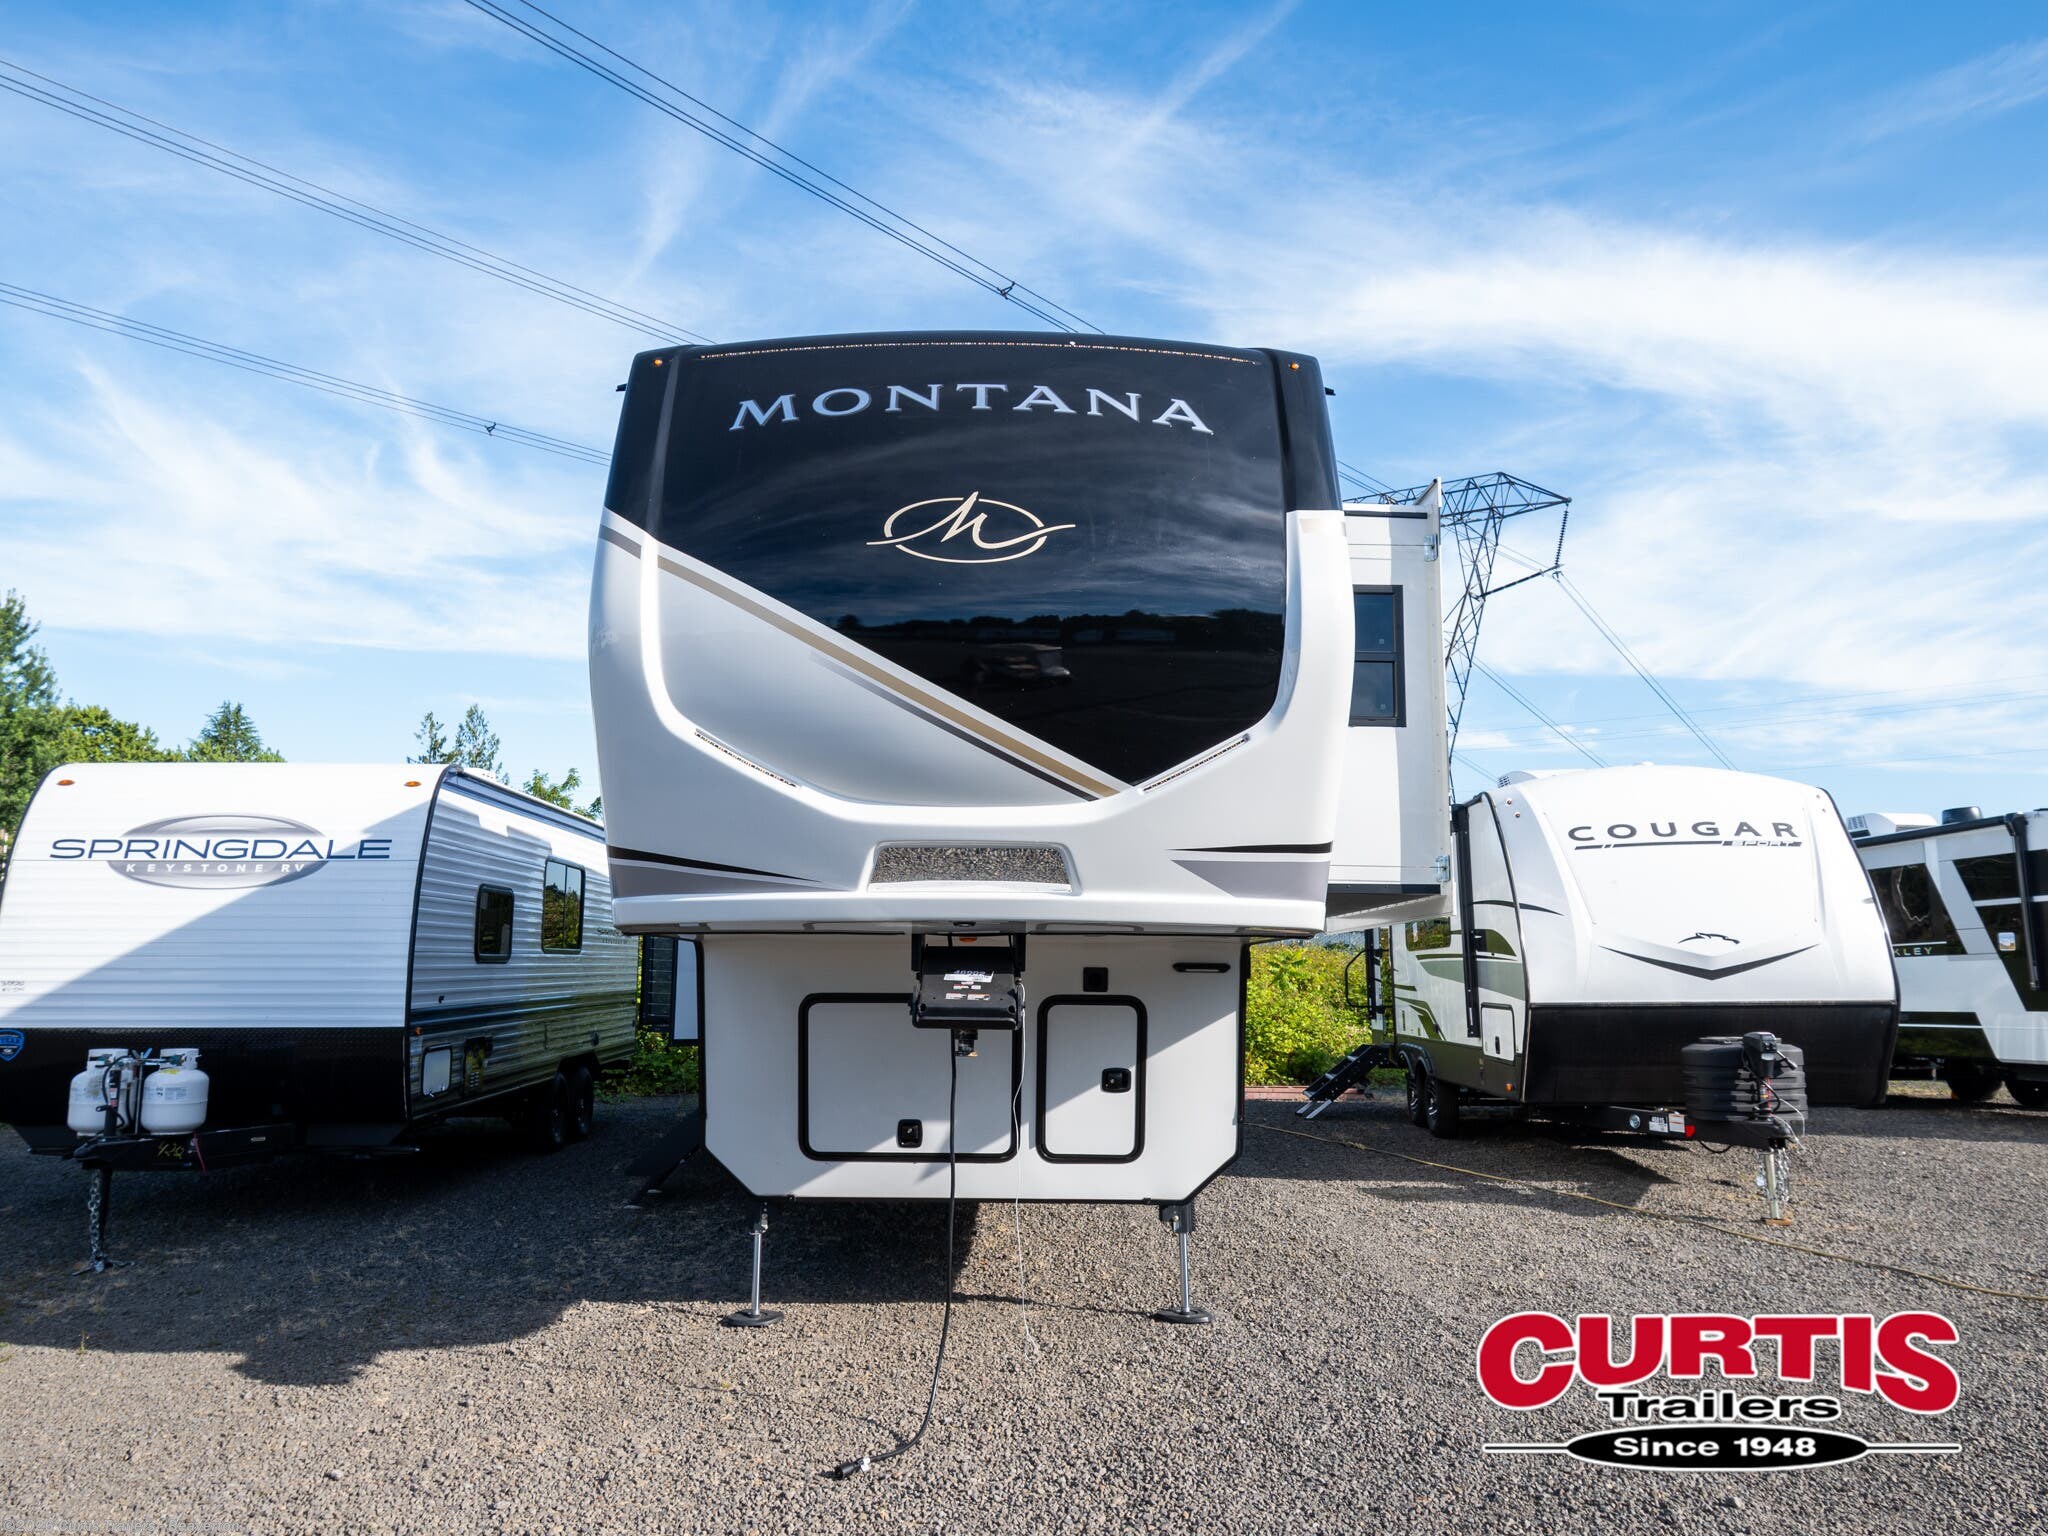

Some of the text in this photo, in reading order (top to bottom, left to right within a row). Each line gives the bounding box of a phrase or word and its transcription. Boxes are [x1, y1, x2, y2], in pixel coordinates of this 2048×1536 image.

[729, 382, 1215, 436] MONTANA
[1567, 821, 1800, 842] COUGAR
[50, 838, 393, 860] SPRINGDALE
[126, 863, 306, 873] KEYSTONE RV
